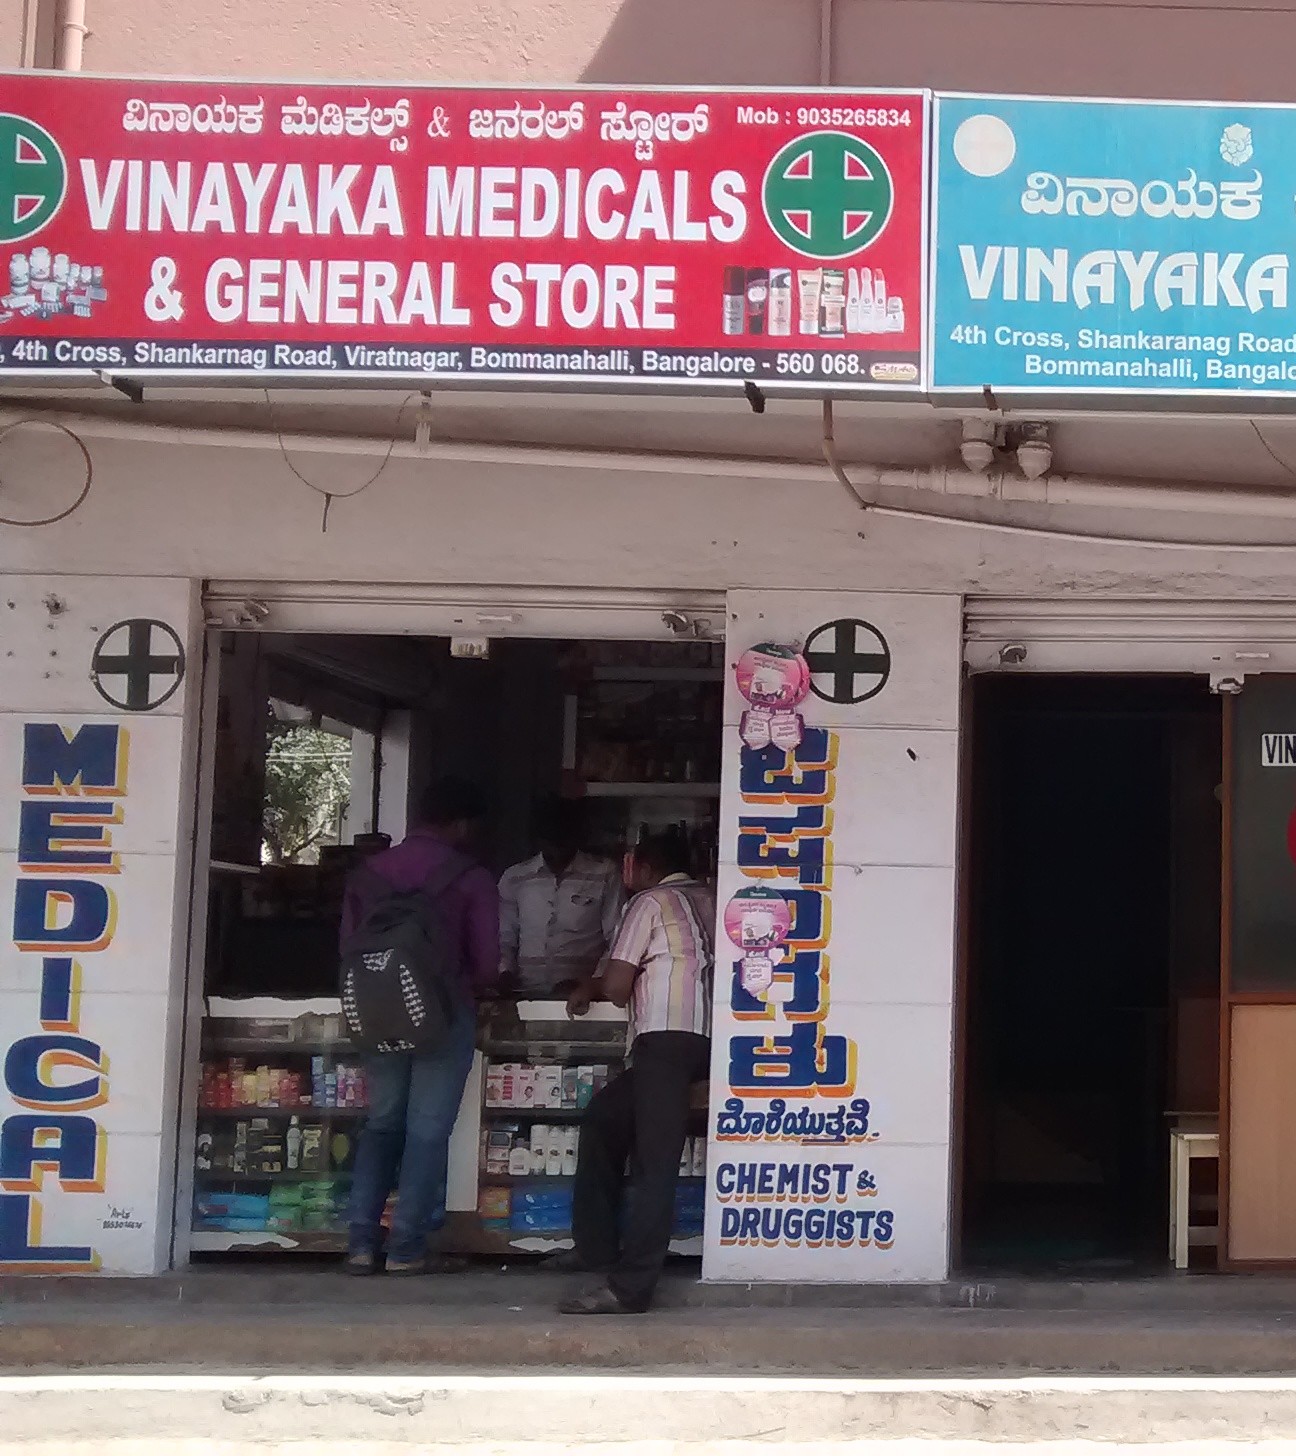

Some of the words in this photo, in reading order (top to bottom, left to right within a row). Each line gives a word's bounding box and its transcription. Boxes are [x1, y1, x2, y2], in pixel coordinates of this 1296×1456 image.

[122, 94, 265, 134] ವಿನಾಯಕ
[280, 96, 410, 152] ಮೆಡಿಕಲ್ಸ್
[427, 106, 451, 137] &
[468, 100, 585, 141] ಜನರಲ್
[600, 102, 710, 161] ಸ್ಟೋರ್
[736, 107, 779, 125] Mob
[796, 108, 911, 126] 9035265834
[80, 158, 404, 235] VINAYAKA
[425, 165, 748, 243] MEDICALS
[1021, 167, 1263, 221] ವಿನಾಯಕ
[143, 256, 184, 322] &
[205, 257, 471, 326] GENERAL
[489, 262, 677, 330] STORE
[959, 245, 1289, 314] VINAYAKA
[12, 339, 48, 362] 4th
[55, 341, 127, 365] Cross,
[134, 342, 268, 370] Shankarnag
[274, 345, 337, 369] Road,
[344, 346, 463, 372] Viratnagar,
[470, 348, 636, 375] Bommanahalli,
[643, 351, 755, 378] Bangalore
[776, 354, 815, 374] 560
[821, 355, 865, 375] 068.
[950, 324, 987, 345] 4th
[994, 326, 1070, 351] Cross,
[1078, 328, 1230, 355] Shankaranag
[1025, 355, 1198, 381] Bommanahalli,
[0, 722, 129, 1272] MEDICAL
[716, 1163, 853, 1202] CHEMIST
[857, 1170, 878, 1196] &
[720, 1207, 895, 1250] DRUGGISTS
